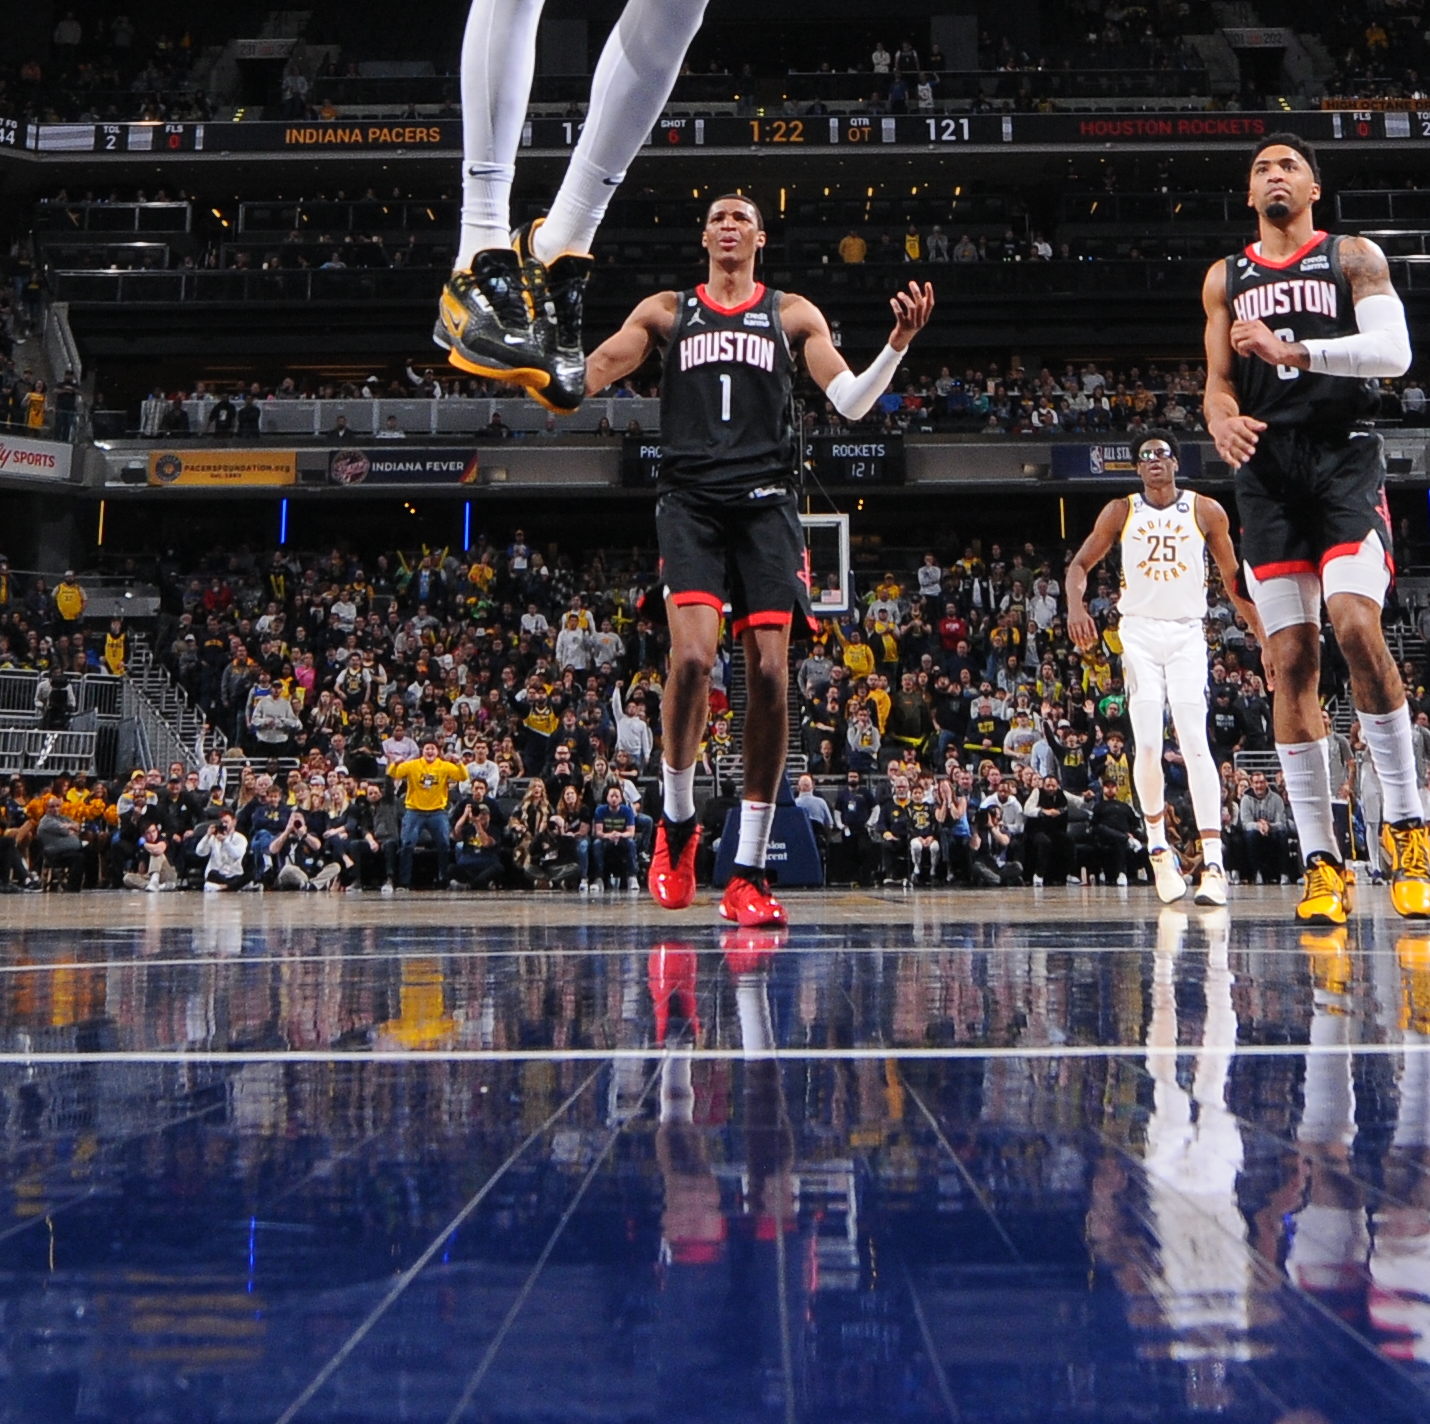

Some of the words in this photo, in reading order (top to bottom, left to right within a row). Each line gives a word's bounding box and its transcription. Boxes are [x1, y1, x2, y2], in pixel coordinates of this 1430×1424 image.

[1326, 100, 1357, 111] HIGH
[661, 119, 686, 128] SHOT
[850, 117, 871, 127] QTR
[1353, 113, 1371, 121] FLS
[285, 127, 363, 144] INDIANA
[368, 127, 441, 143] PACERS
[749, 120, 804, 142] 1:22
[848, 127, 871, 142] OT
[926, 119, 970, 141] 121
[1080, 121, 1171, 136] HOUSTON
[1177, 120, 1265, 136] ROCKETS
[105, 135, 116, 150] 2
[1233, 279, 1337, 321] HOUSTON
[680, 331, 774, 372] HOUSTON
[719, 374, 731, 421] 1
[13, 449, 55, 468] SPORTS
[832, 444, 885, 457] ROCKETS
[372, 462, 422, 472] INDIANA
[425, 461, 464, 471] FEVER
[1132, 518, 1190, 542] INDIANA
[1147, 535, 1176, 562] 25
[1137, 560, 1188, 582] PACERS
